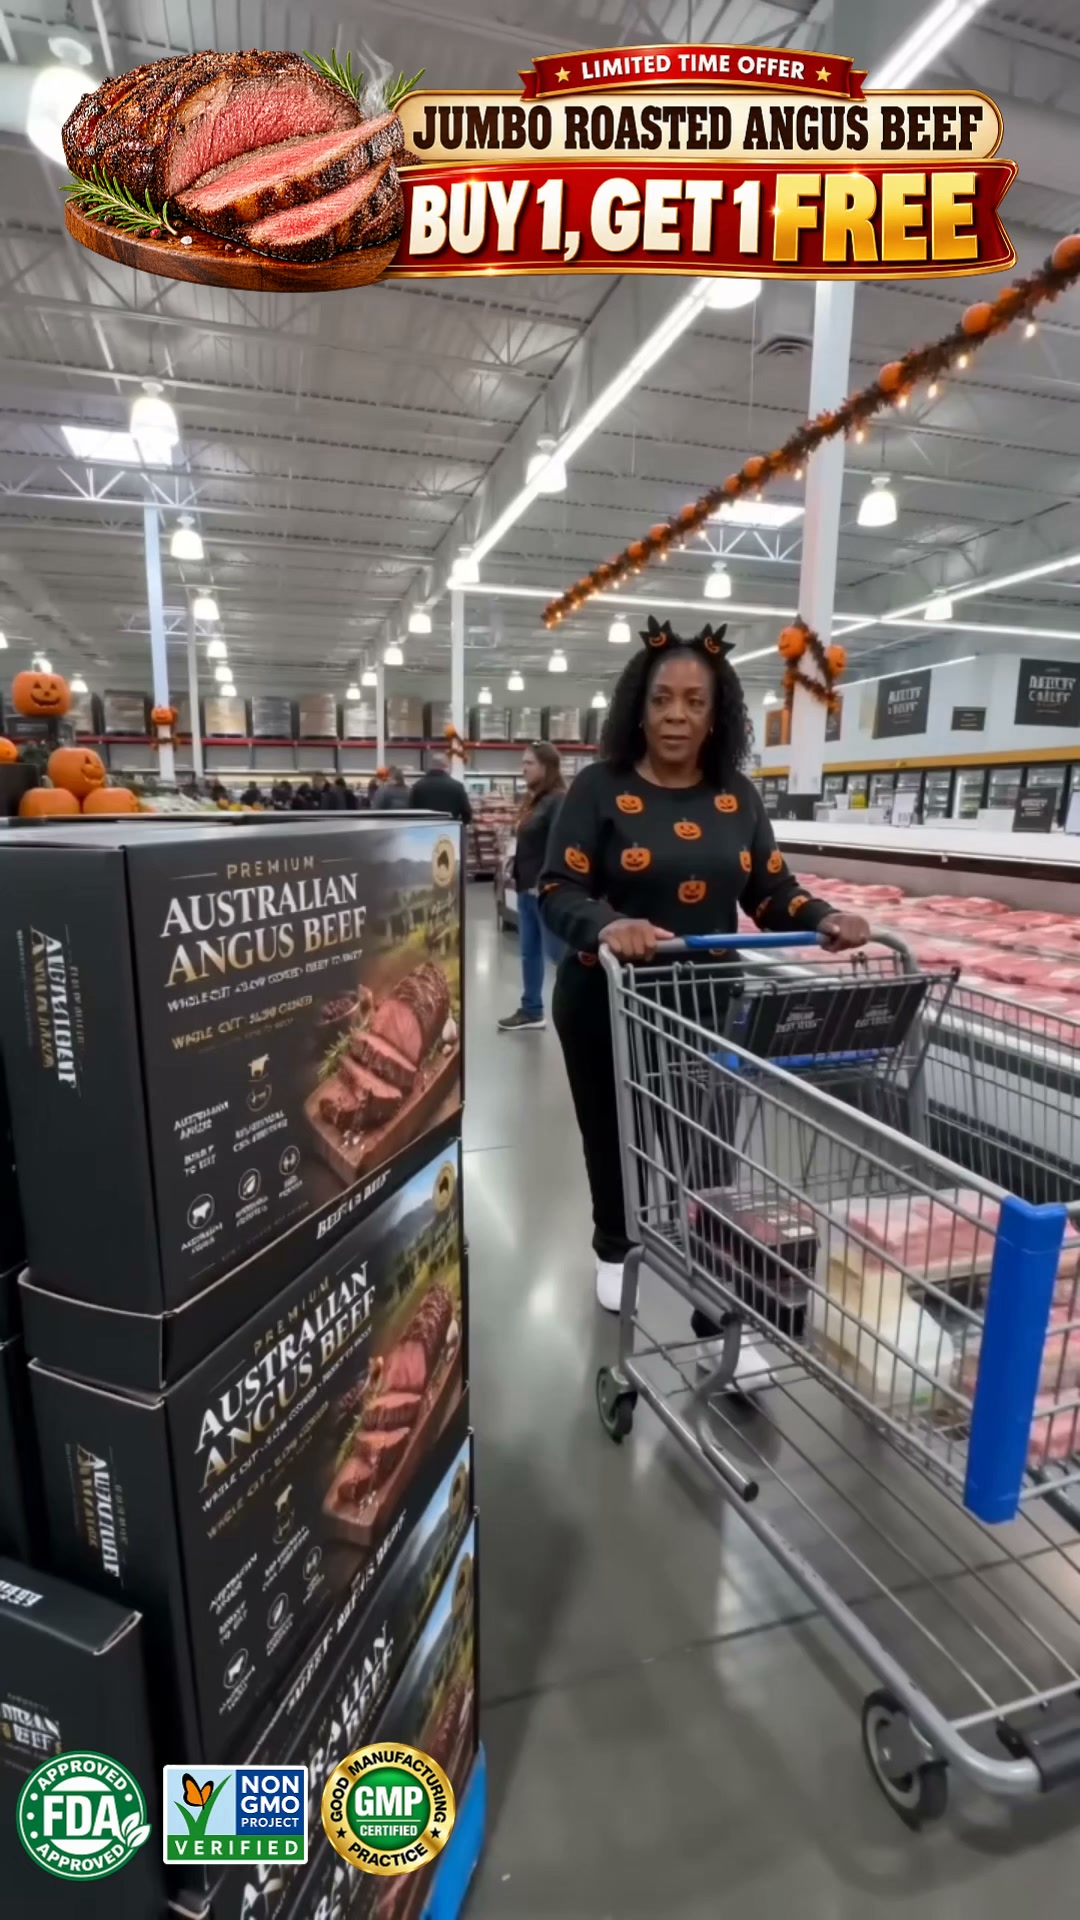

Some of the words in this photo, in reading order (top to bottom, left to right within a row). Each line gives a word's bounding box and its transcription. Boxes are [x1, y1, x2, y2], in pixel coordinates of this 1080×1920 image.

[159, 873, 360, 938] AUSTRALIAN
[227, 856, 315, 880] PREMIUM
[164, 922, 296, 989] ANGUS
[304, 906, 367, 953] BEEF
[254, 1276, 330, 1355] PREMIUM
[195, 1261, 369, 1455] AUSTRALIAN
[198, 1350, 312, 1493] ANGUS
[319, 1285, 377, 1366] BEEF
